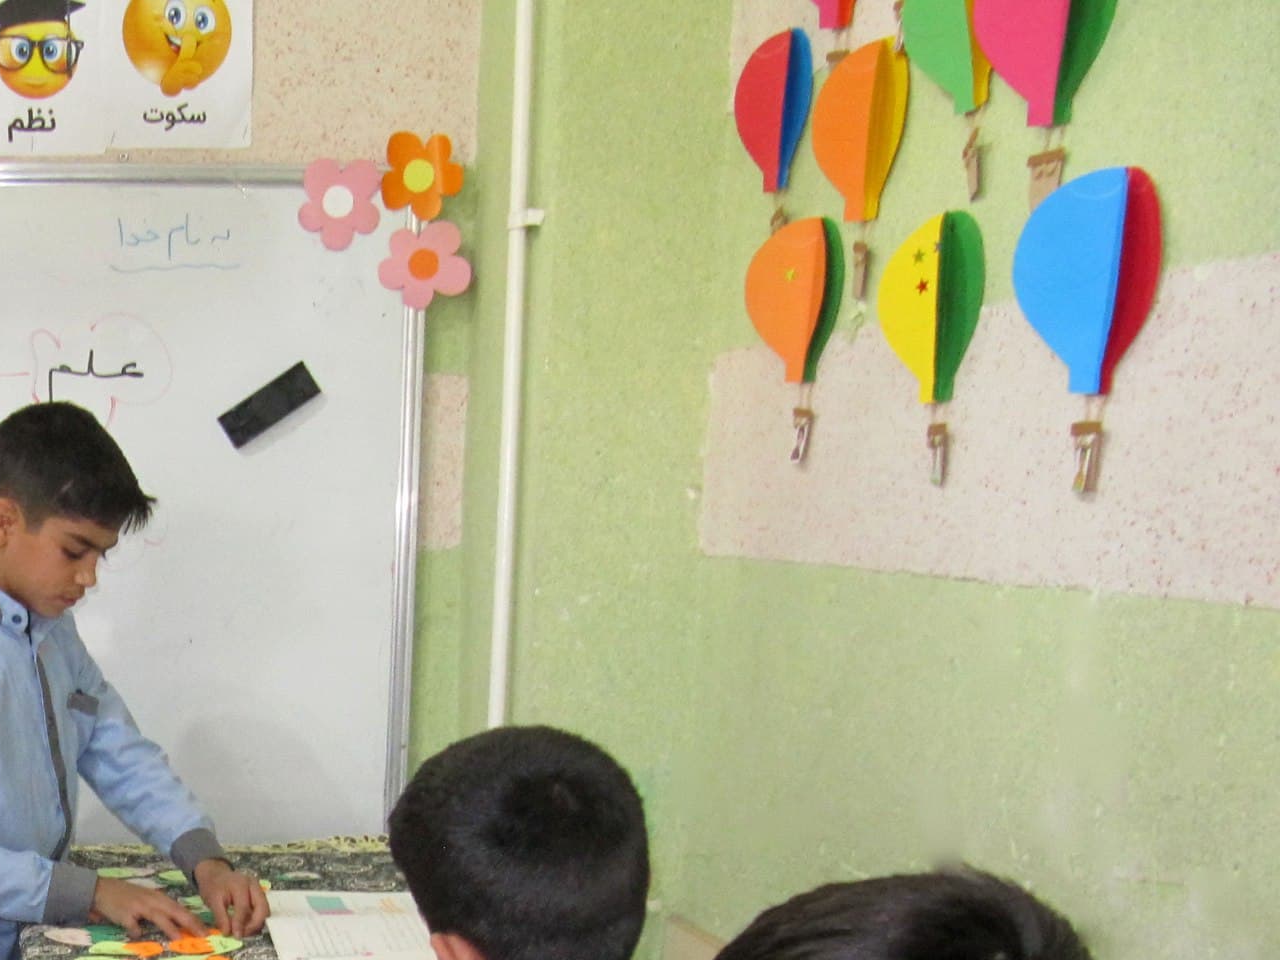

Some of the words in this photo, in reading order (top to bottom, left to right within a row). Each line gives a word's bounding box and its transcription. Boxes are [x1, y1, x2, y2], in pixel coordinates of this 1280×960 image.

[6, 108, 58, 137] نظم
[142, 103, 208, 126] سکوت
[48, 348, 144, 404] علم
